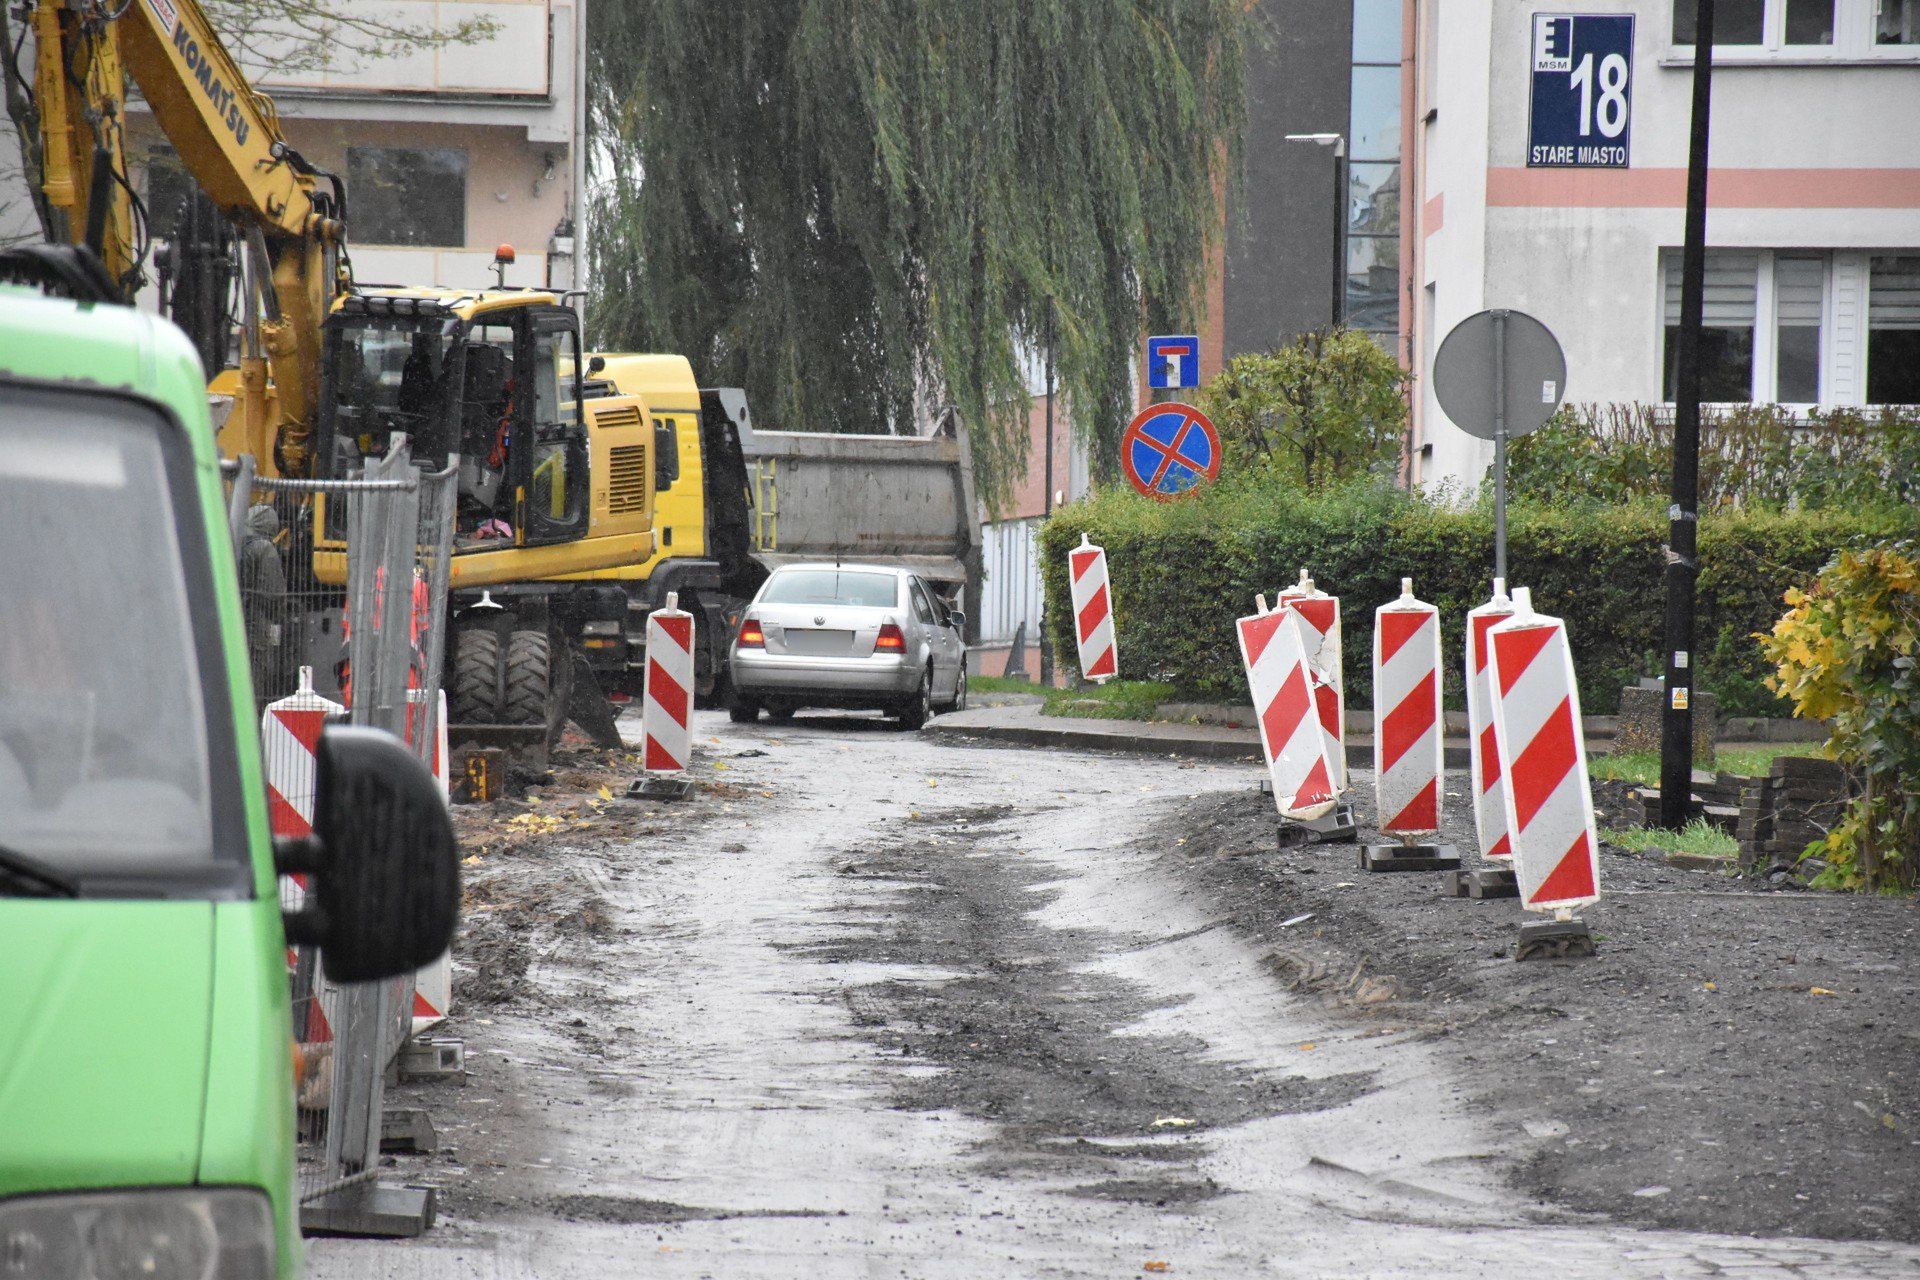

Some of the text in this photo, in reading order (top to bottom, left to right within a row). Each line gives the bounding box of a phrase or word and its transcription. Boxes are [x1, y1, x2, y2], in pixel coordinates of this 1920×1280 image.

[173, 20, 250, 146] KOMATSU
[1538, 61, 1567, 69] MSM
[1571, 53, 1628, 138] 18
[1533, 145, 1625, 164] STARE MIASTO
